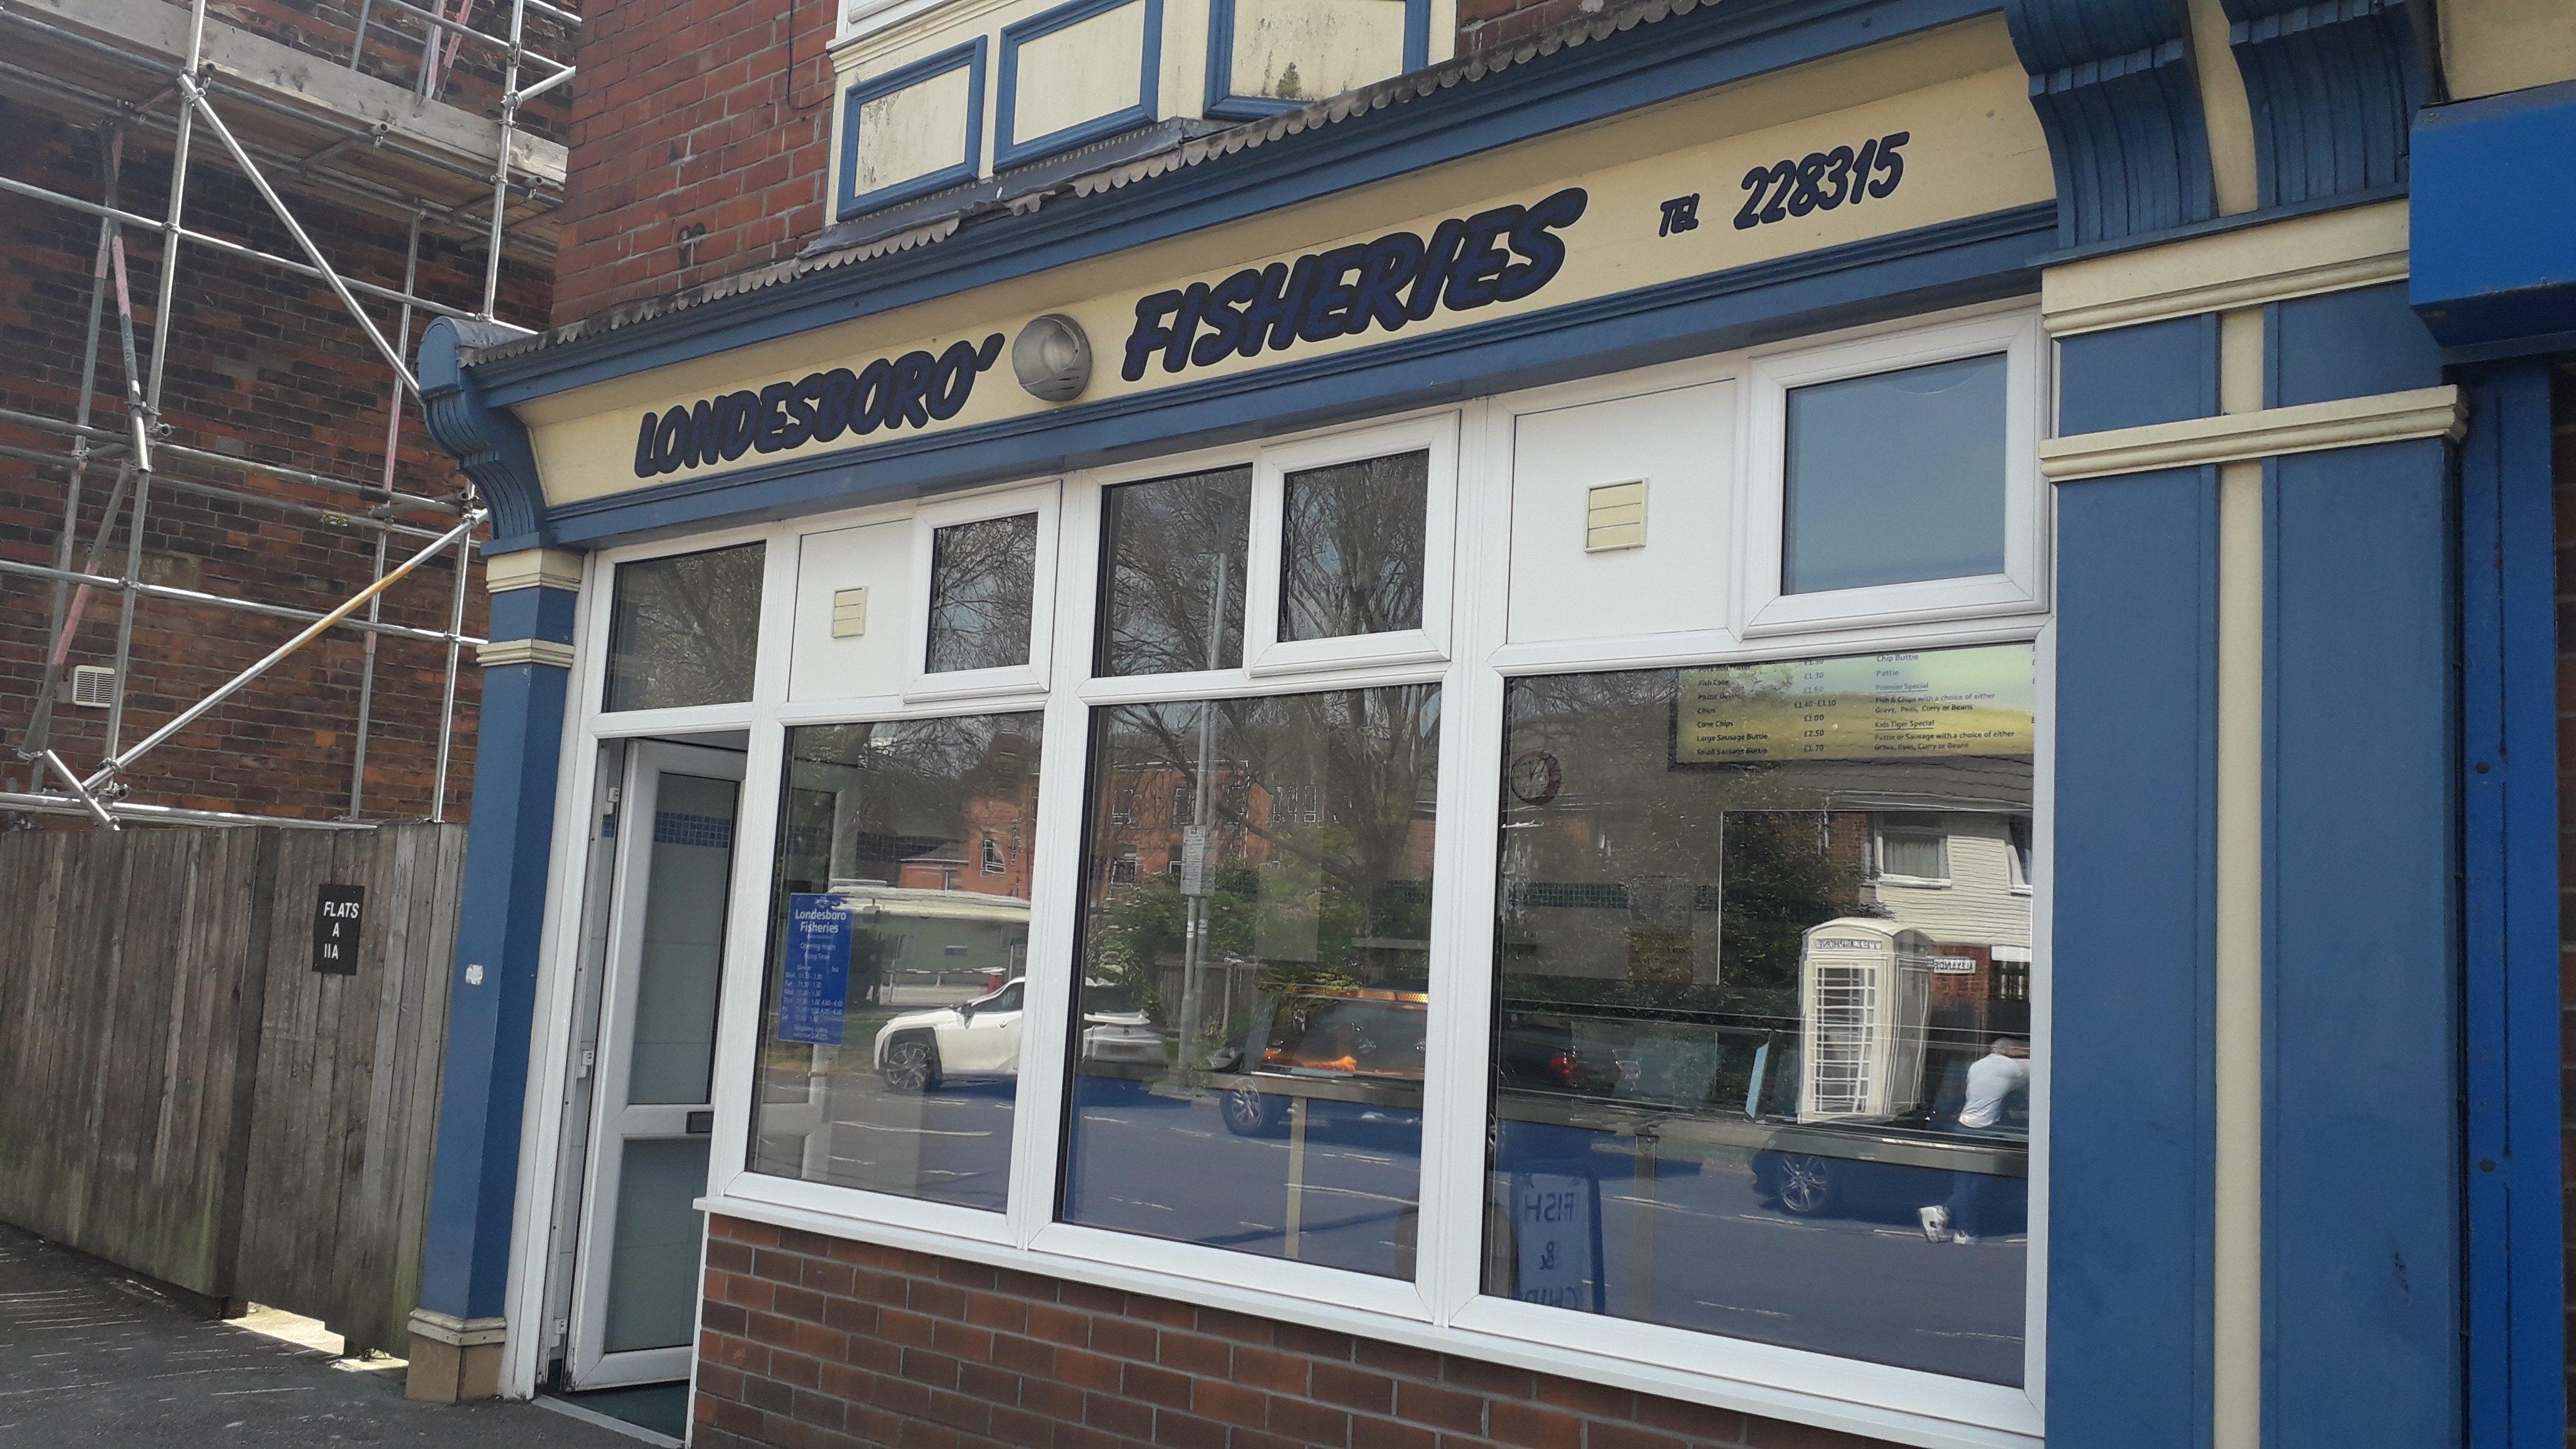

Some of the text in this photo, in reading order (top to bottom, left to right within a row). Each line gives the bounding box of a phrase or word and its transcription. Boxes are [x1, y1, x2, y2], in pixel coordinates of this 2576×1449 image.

[1733, 131, 1910, 230] 228315
[1121, 187, 1588, 382] FISHERIES
[1904, 682, 1929, 691] Special
[1921, 705, 1940, 713] Curry
[1715, 720, 1734, 728] Chips
[1910, 720, 1934, 729] Special
[1697, 733, 1768, 743] Large Sausage Buttie
[1905, 733, 1934, 741] Sausage
[323, 901, 359, 919] FLATS
[794, 909, 847, 922] Londesboro
[332, 922, 339, 937] A
[799, 920, 839, 934] Fisheries
